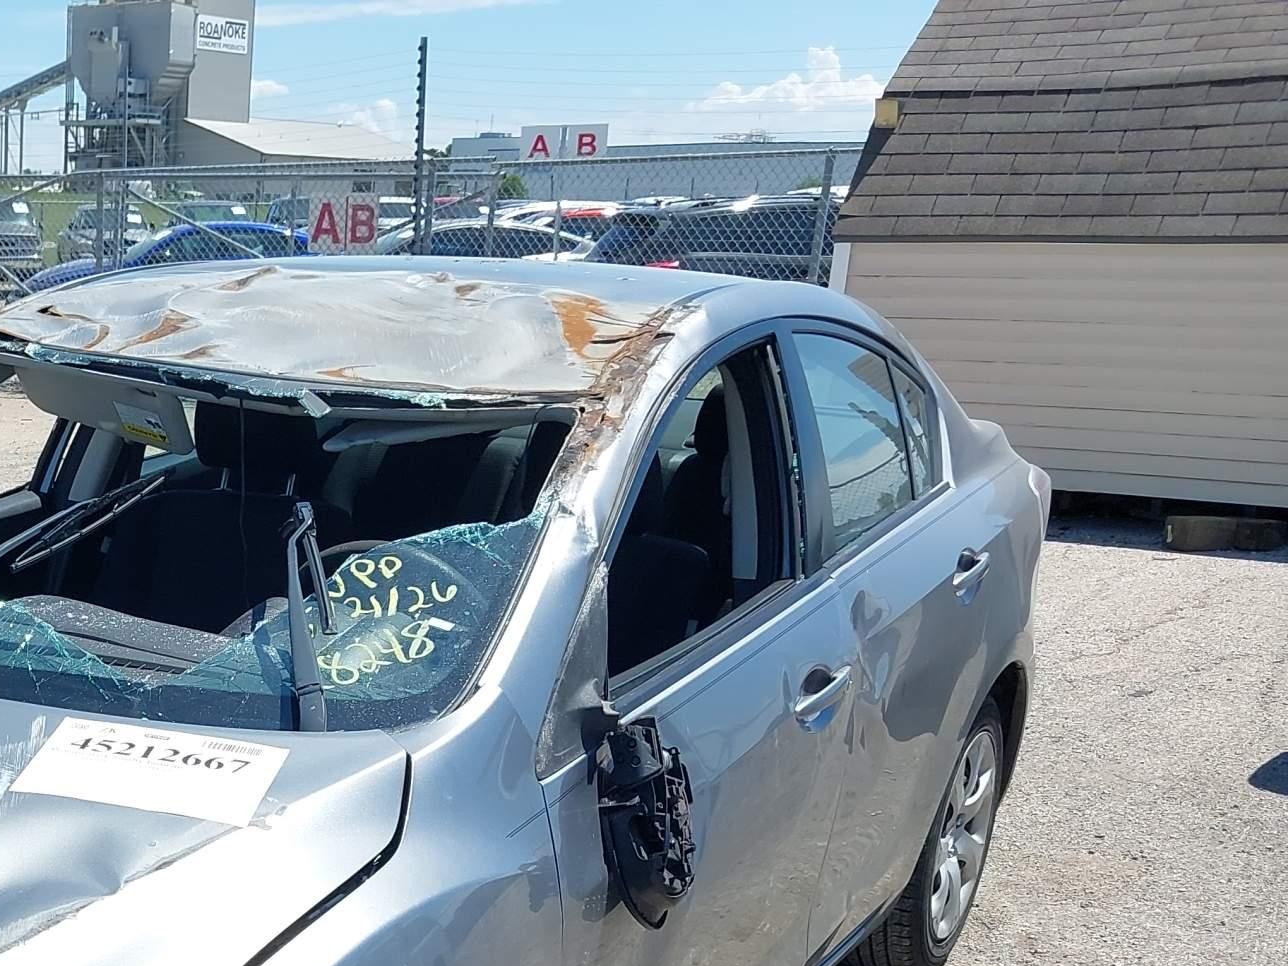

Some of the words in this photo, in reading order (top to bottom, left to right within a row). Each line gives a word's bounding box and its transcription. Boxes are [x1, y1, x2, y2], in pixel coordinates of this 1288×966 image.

[199, 21, 246, 40] ROANOKE
[528, 134, 550, 158] A
[577, 133, 597, 156] B
[311, 202, 341, 243] A
[350, 204, 376, 243] B
[70, 737, 252, 774] 45212667
